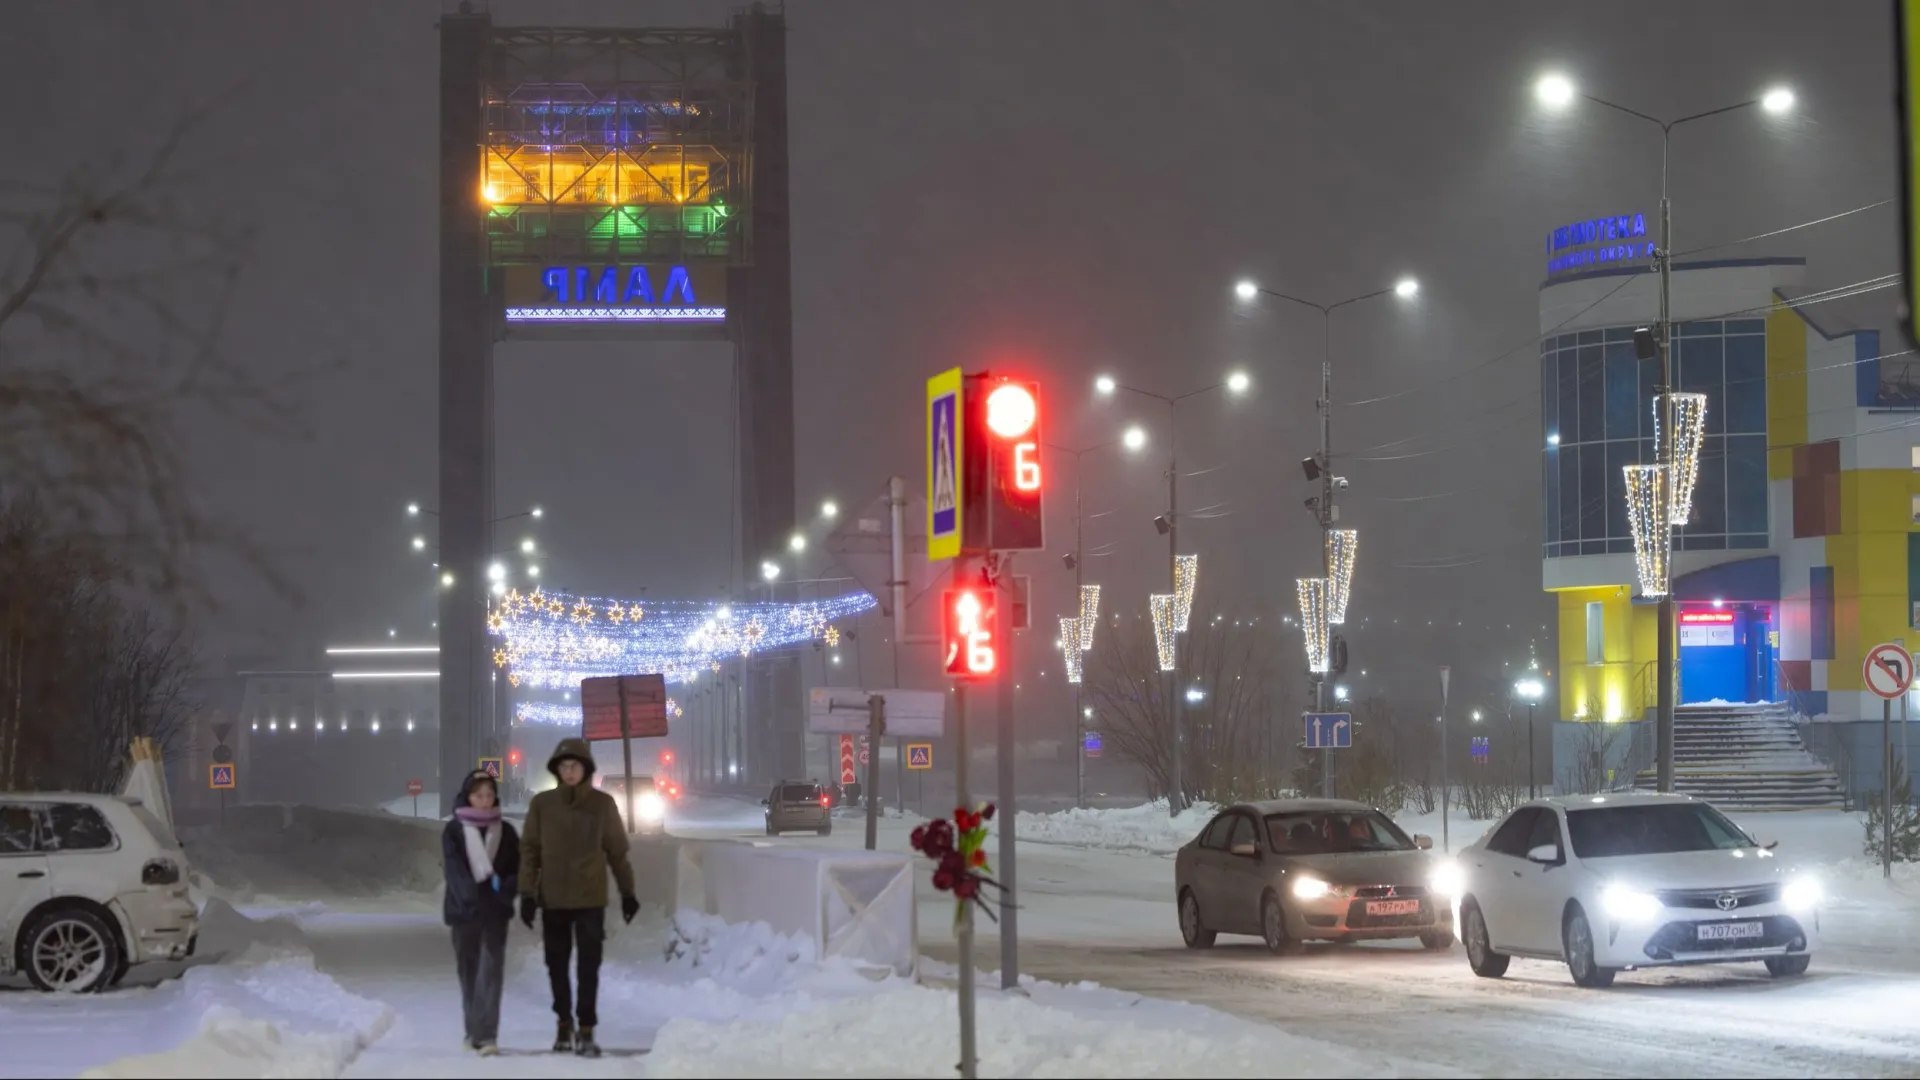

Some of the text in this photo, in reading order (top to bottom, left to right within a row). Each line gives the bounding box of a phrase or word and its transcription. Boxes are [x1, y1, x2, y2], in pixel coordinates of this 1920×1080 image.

[1547, 213, 1646, 255] ИБЛИОТЕКА
[541, 265, 696, 303] ЯМАЛ
[1014, 443, 1041, 491] 6
[967, 631, 994, 673] 6
